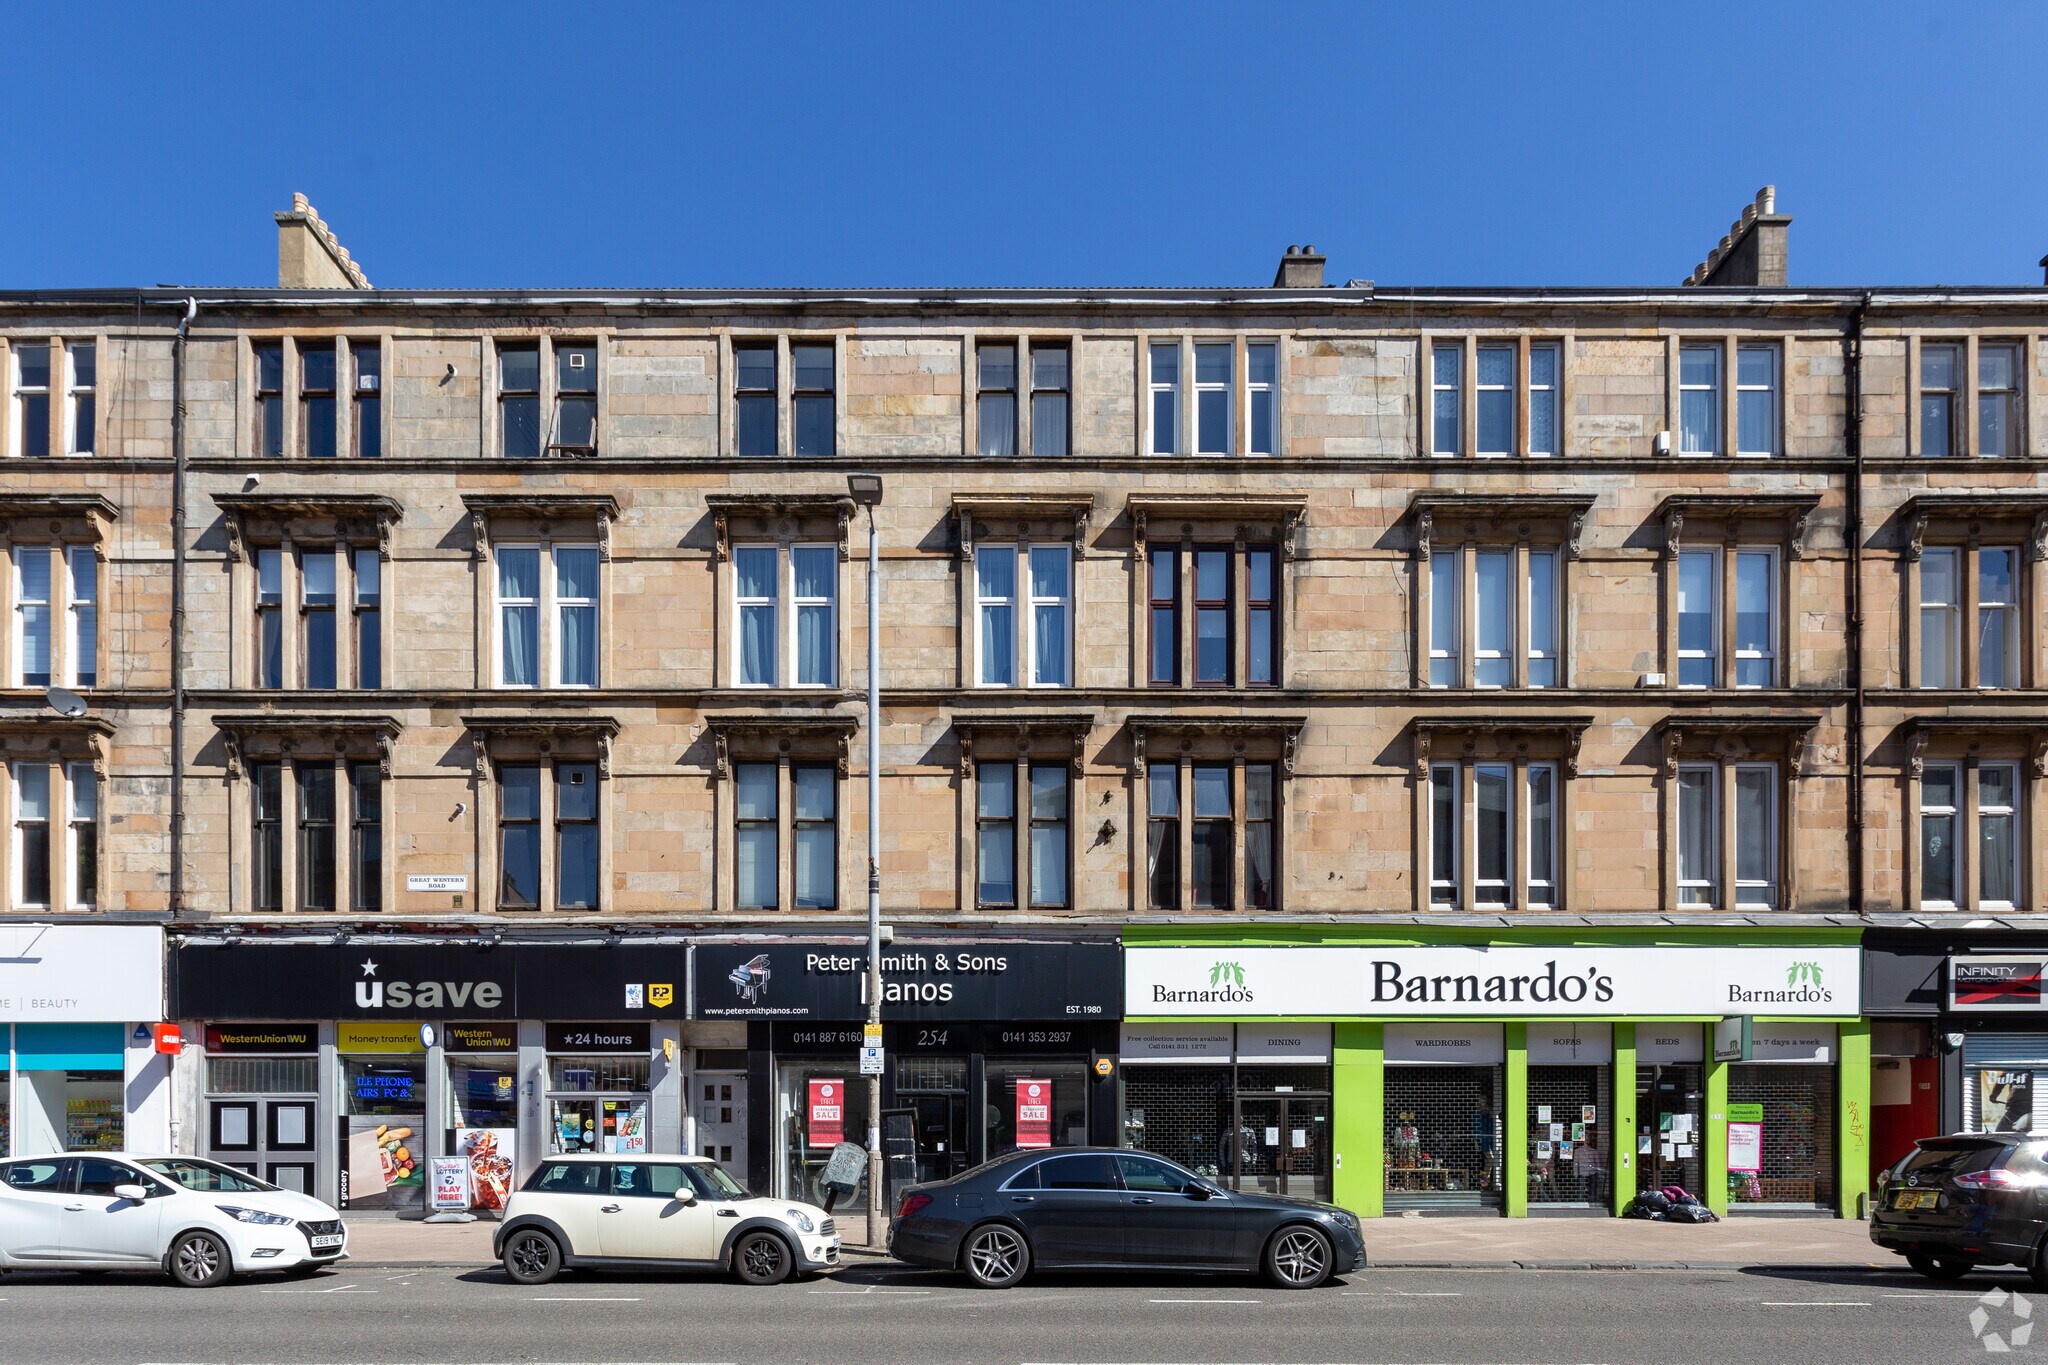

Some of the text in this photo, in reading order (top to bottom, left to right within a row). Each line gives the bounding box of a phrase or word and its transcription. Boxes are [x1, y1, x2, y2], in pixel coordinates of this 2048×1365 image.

[806, 953, 1007, 971] Peter mith & Sons
[1957, 966, 2016, 976] INFINITY
[1370, 960, 1614, 1003] Barnardo's
[1152, 984, 1254, 1003] Barnardo's
[1728, 984, 1832, 1003] Barnardo's
[31, 999, 78, 1008] BEAUTY
[704, 1007, 809, 1015] www.petersmithpianos.com
[1066, 1005, 1102, 1013] EST. 1980
[453, 1029, 492, 1038] Western
[793, 1032, 816, 1043] 0141
[819, 1032, 837, 1043] 887
[839, 1031, 863, 1042] 6160
[918, 1029, 948, 1046] 254
[1002, 1031, 1072, 1042] 0141 353 2937
[349, 1034, 417, 1044] Money transfer
[466, 1037, 492, 1046] Union
[575, 1033, 633, 1045] 24 hours
[1267, 1038, 1301, 1046] DINING
[1415, 1039, 1471, 1047] WARDROBES
[1553, 1038, 1582, 1046] SOFAS
[1655, 1038, 1680, 1046] BEDS
[1771, 1039, 1790, 1047] days
[374, 1077, 413, 1087] PHONE
[356, 1088, 408, 1098] AIRS PC &
[816, 1111, 838, 1119] SALE
[1022, 1111, 1045, 1119] SALE
[341, 1169, 349, 1201] grocery
